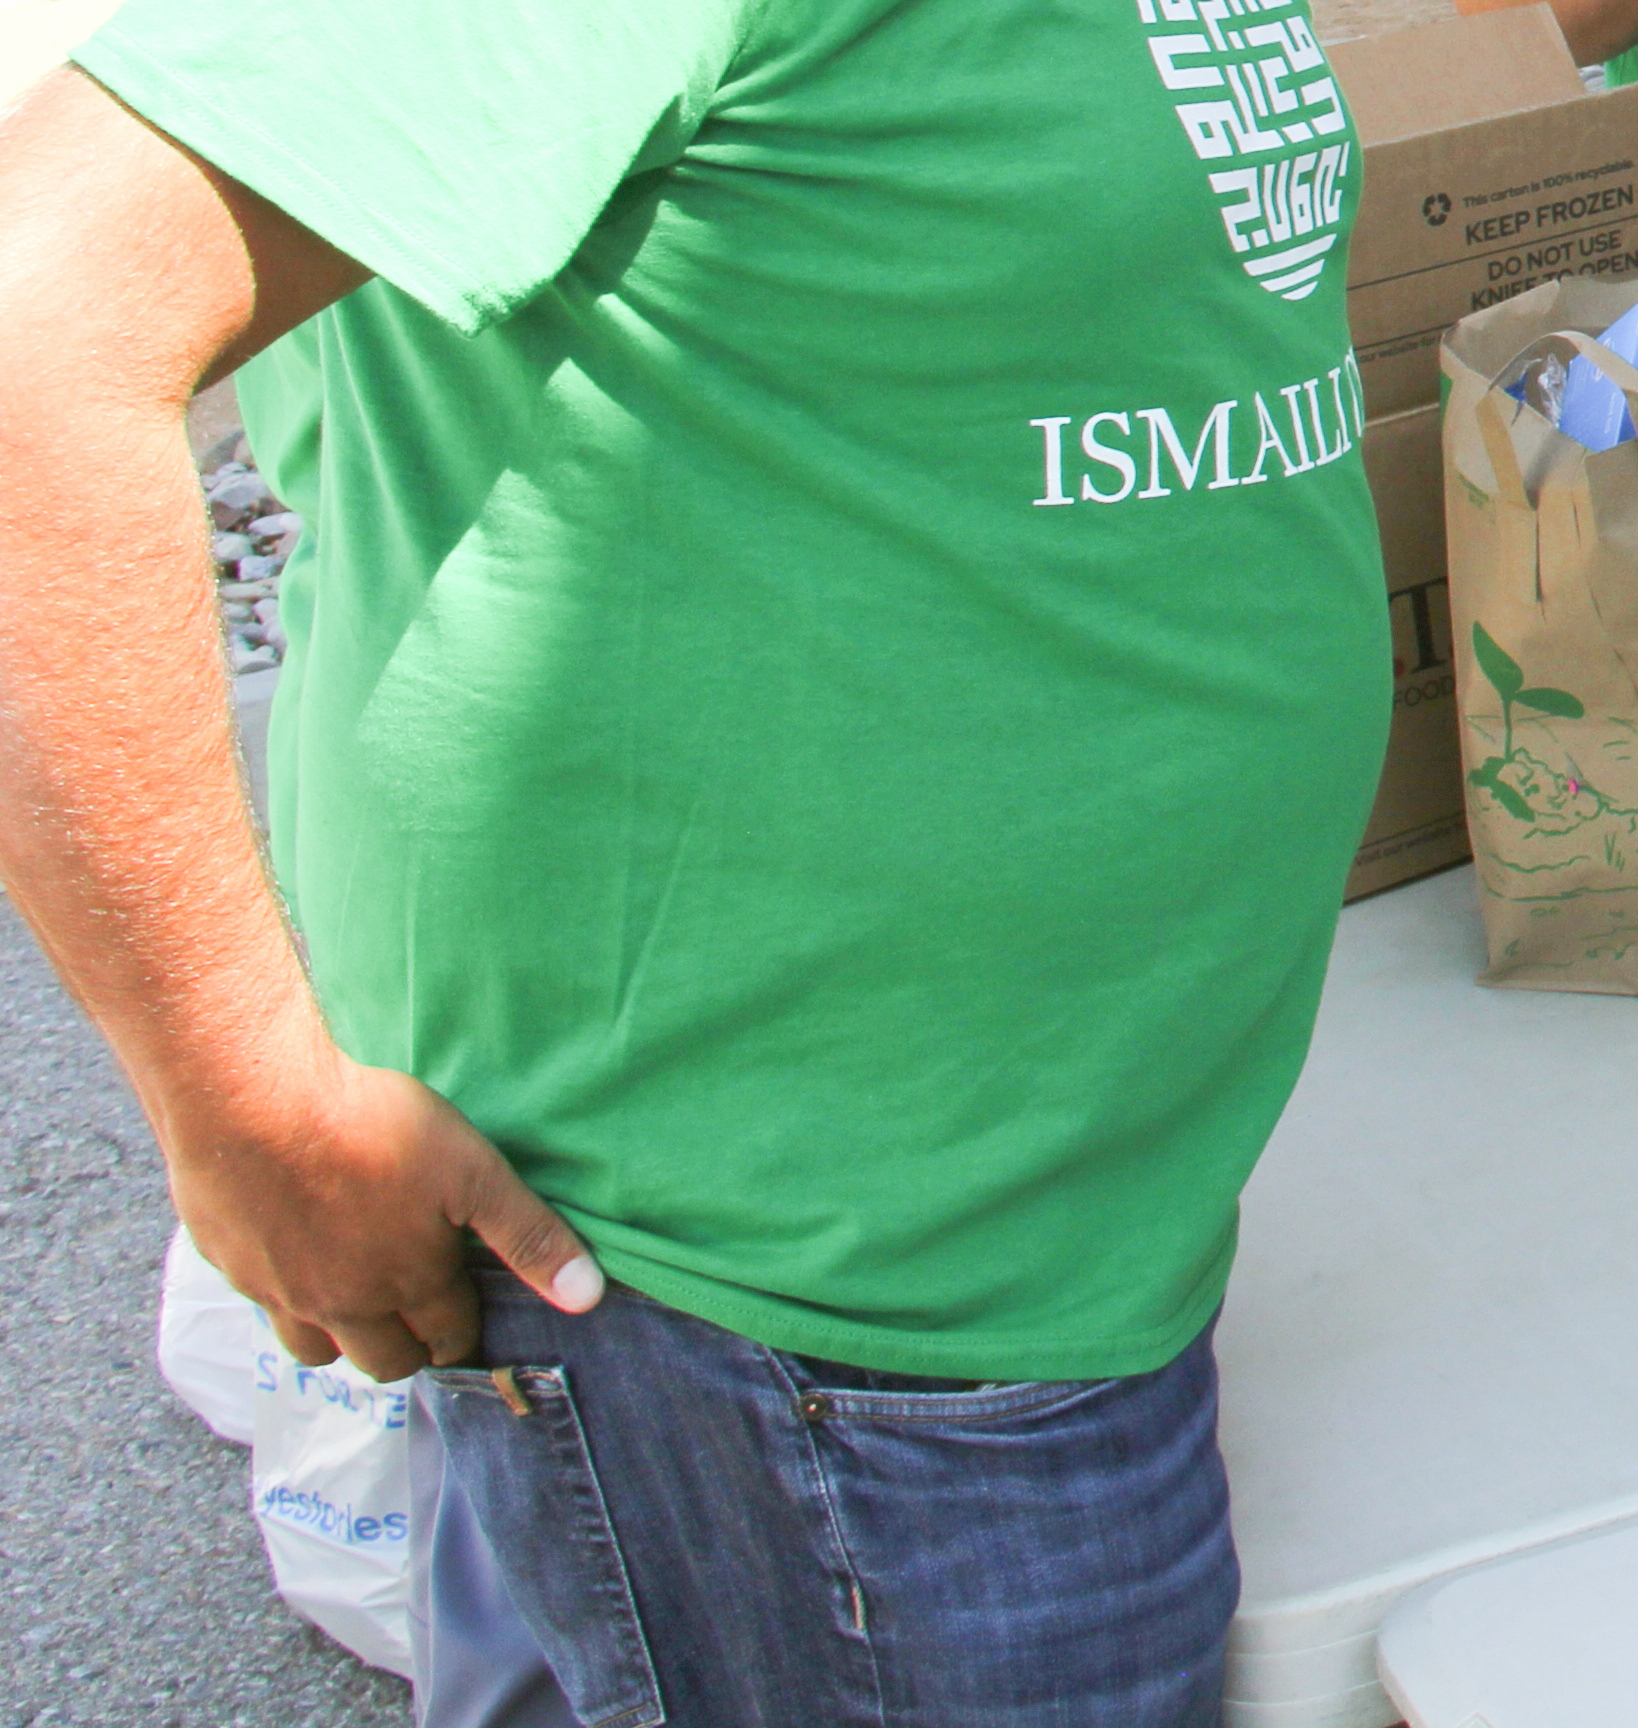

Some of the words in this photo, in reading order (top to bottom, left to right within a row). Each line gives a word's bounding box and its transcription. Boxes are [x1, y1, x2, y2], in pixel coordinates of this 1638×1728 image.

[1462, 195, 1487, 208] This
[1488, 188, 1529, 204] carton
[1531, 182, 1540, 193] is
[1542, 173, 1573, 190] 100%
[1575, 160, 1634, 183] recyclable
[1466, 211, 1531, 245] KEEP
[1537, 184, 1634, 227] FROZEN
[1488, 256, 1522, 281] DO
[1527, 242, 1574, 270] NOT
[1579, 231, 1621, 256] USE
[1029, 367, 1352, 506] ISMAILI
